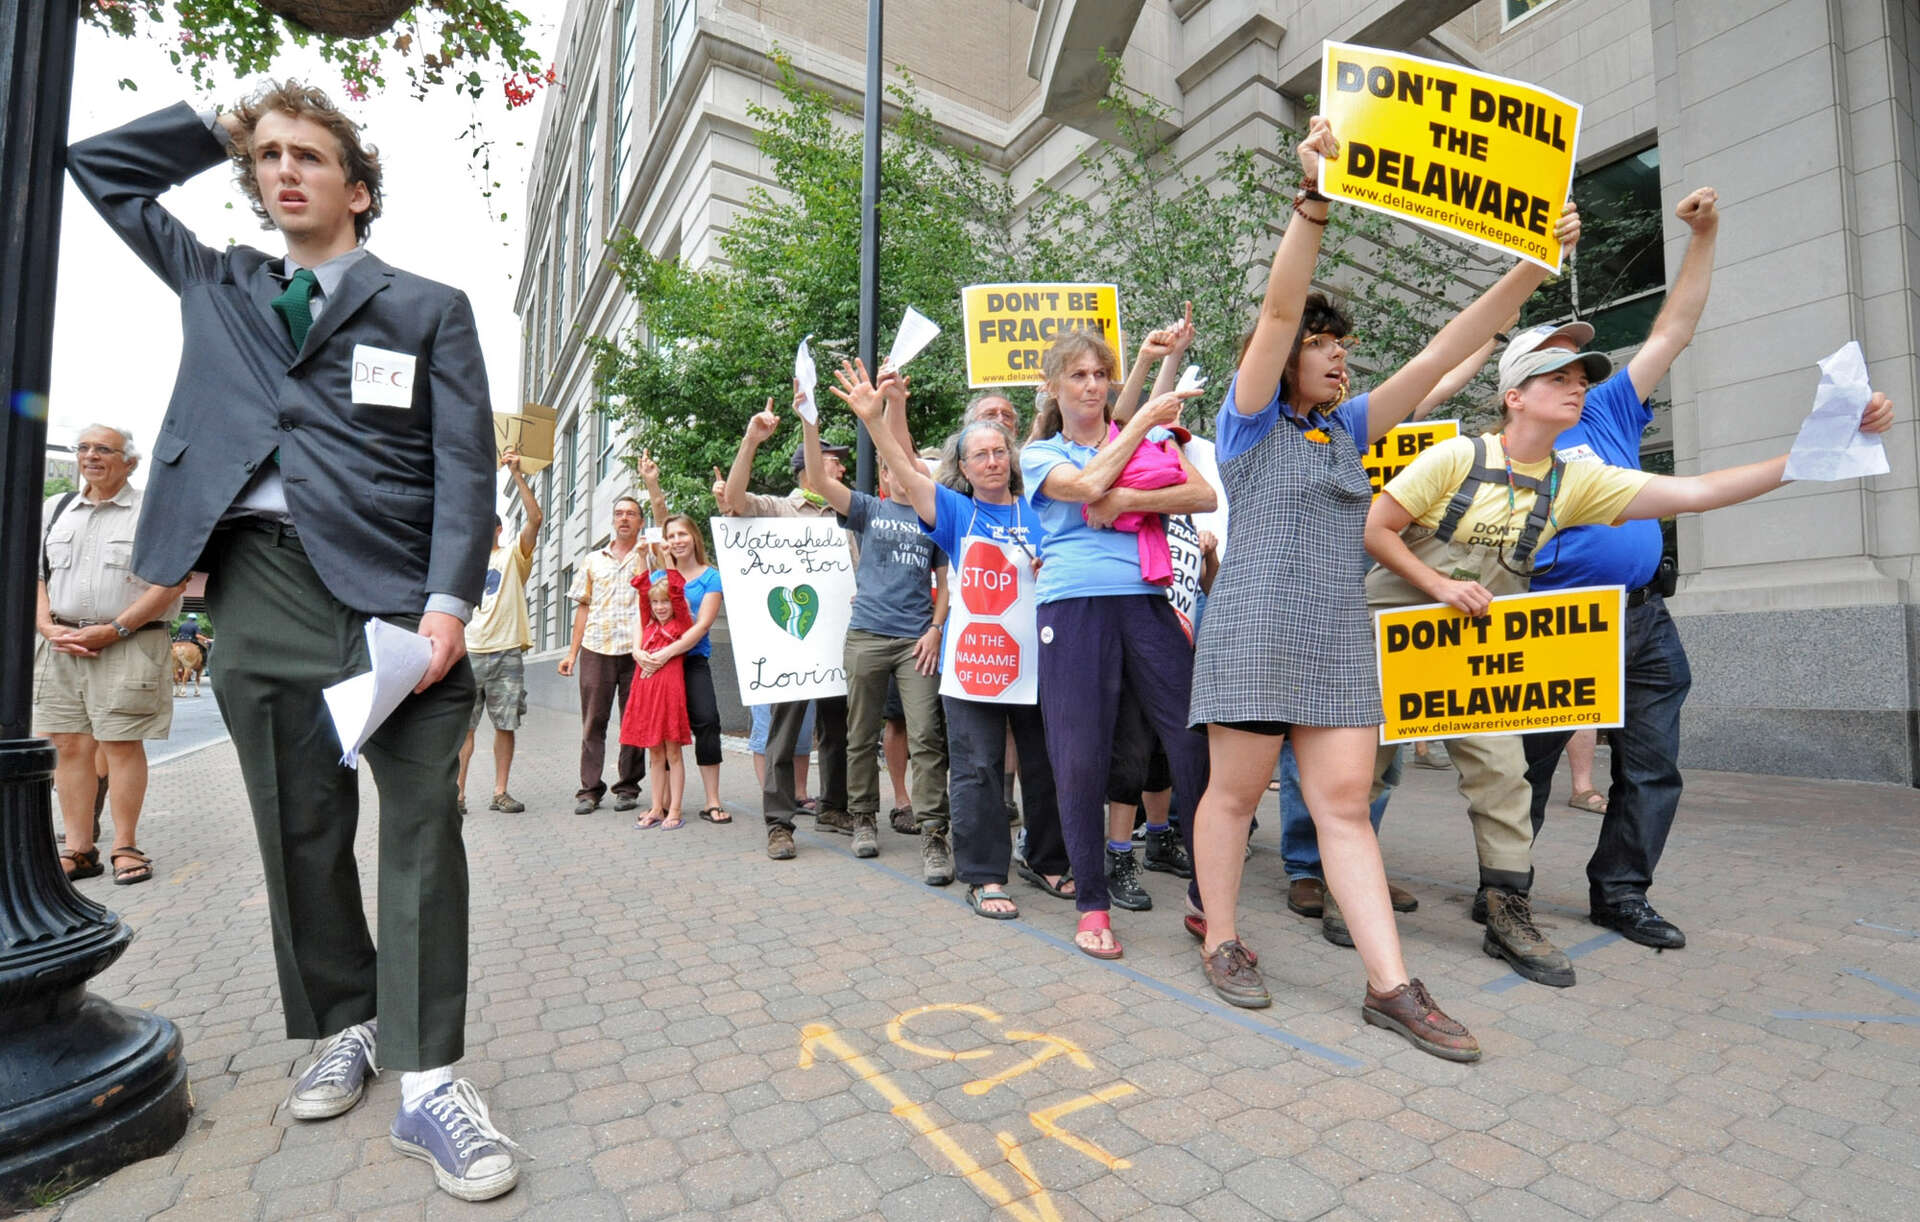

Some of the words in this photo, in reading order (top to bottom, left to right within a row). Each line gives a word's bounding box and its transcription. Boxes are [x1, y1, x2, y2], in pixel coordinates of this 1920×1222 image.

[1336, 60, 1457, 113] DON'T
[1470, 88, 1566, 153] DRILL
[1429, 121, 1489, 162] THE
[1347, 141, 1550, 236] DELAWARE
[1342, 182, 1548, 260] www.delawareriverkeeper.org
[987, 292, 1060, 313] DON'T
[1067, 292, 1099, 311] BE
[1397, 432, 1434, 457] BE
[720, 523, 847, 549] Watersheds
[899, 543, 913, 551] OF
[740, 549, 792, 575] Are
[795, 549, 850, 573] For
[891, 550, 929, 569] MIND
[962, 566, 1012, 592] STOP
[964, 633, 977, 646] IN
[981, 634, 1006, 648] THE
[1387, 614, 1492, 653] DON'T
[1504, 602, 1608, 641] DRILL
[1467, 651, 1524, 676] THE
[958, 670, 973, 682] OF
[976, 672, 1009, 686] LOVE
[1399, 677, 1596, 721] DELAWARE
[1397, 711, 1601, 736] www.delawareriverkeeper.org
